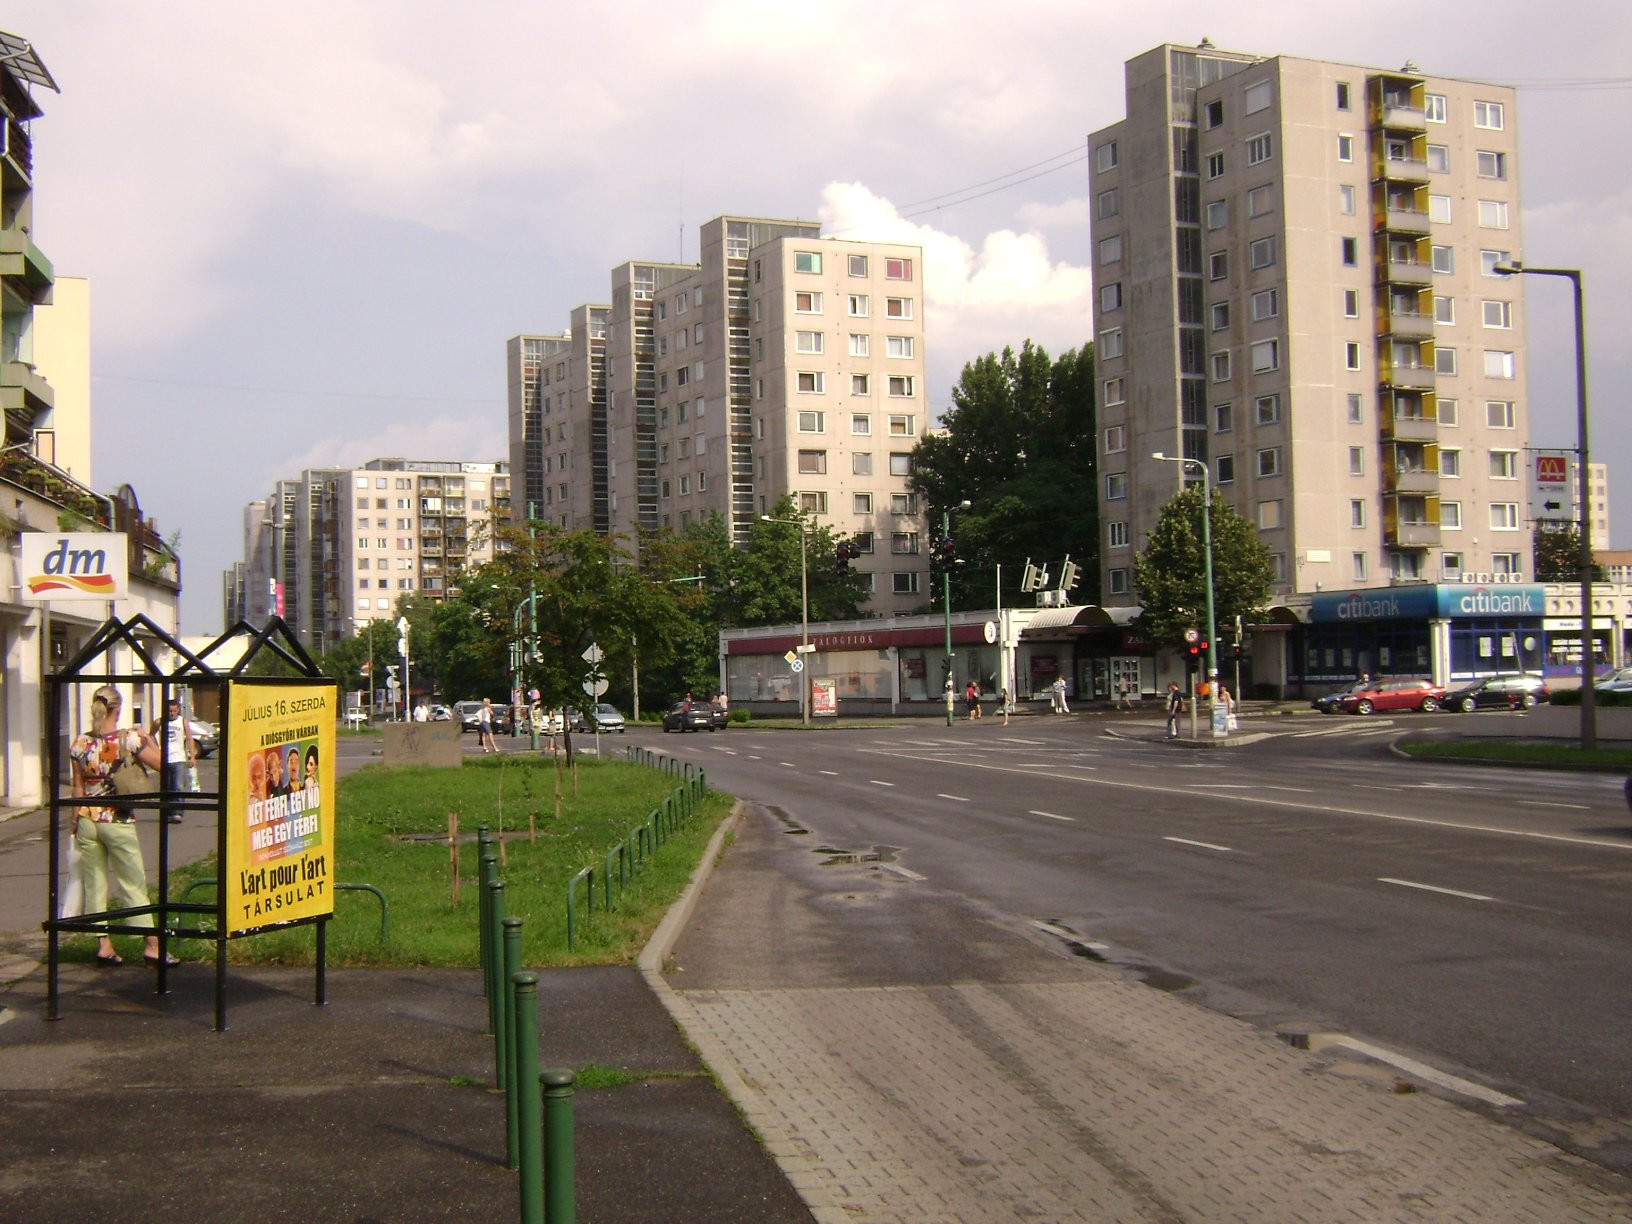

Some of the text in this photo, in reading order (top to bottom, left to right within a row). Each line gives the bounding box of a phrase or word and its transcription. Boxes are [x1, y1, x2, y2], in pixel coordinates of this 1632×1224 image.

[43, 539, 106, 575] dm
[1337, 597, 1401, 619] citibank
[1461, 590, 1533, 613] citibank
[242, 704, 272, 722] JÚLIUS
[274, 700, 289, 716] 16.
[290, 697, 325, 714] SZERDA
[260, 734, 266, 747] A
[296, 725, 318, 739] VÁRBAN
[248, 798, 264, 827] KÉT
[264, 793, 291, 822] FÉRFI,
[290, 789, 307, 815] EGY
[252, 826, 274, 851] MEG
[274, 820, 293, 845] EGY
[293, 815, 318, 838] FÉRFI
[269, 863, 298, 892] pour
[243, 881, 324, 919] TÁRSULAT
